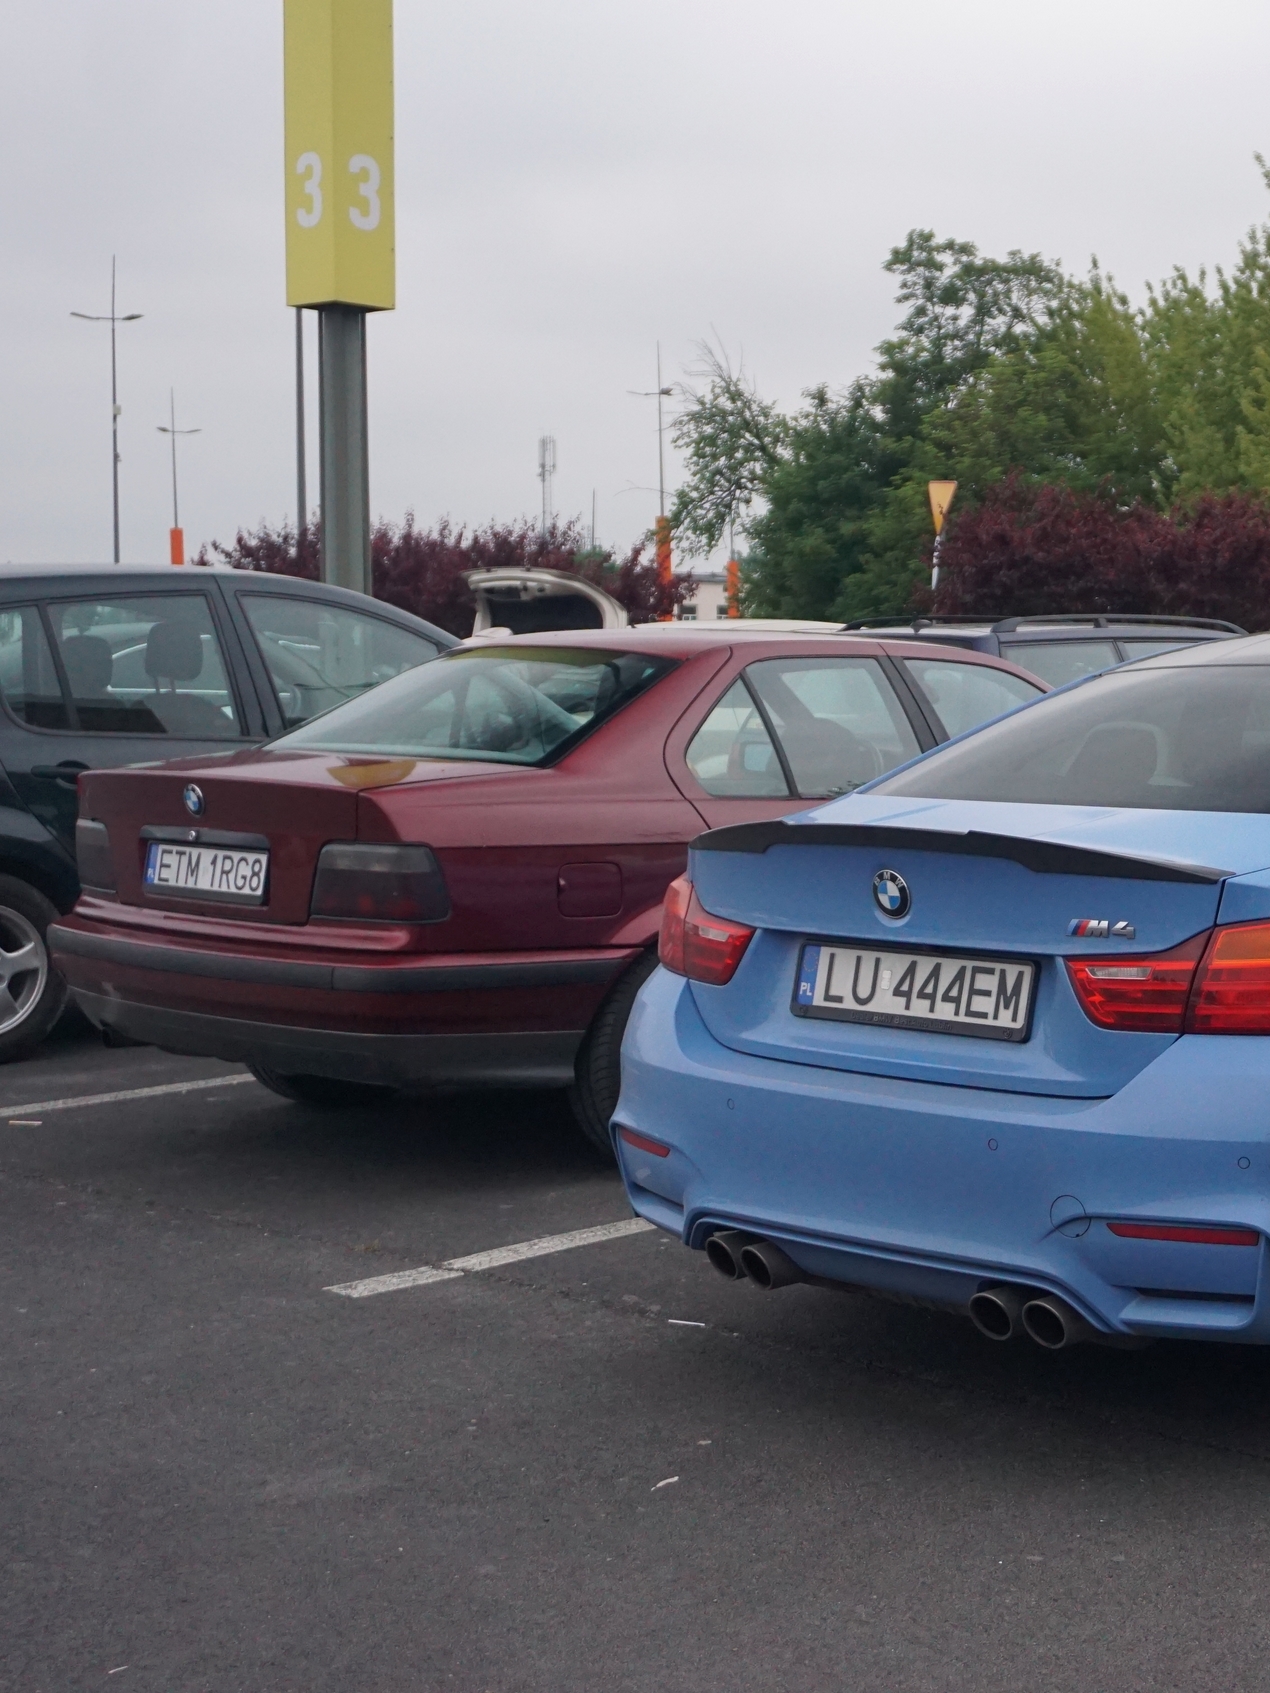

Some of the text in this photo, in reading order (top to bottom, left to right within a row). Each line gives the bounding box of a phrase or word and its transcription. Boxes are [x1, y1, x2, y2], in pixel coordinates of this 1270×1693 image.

[296, 151, 323, 229] 3
[348, 153, 382, 231] 3
[157, 848, 263, 892] ETM 1RG8
[874, 871, 904, 888] BMW
[1082, 919, 1135, 940] M4
[800, 982, 813, 996] PL
